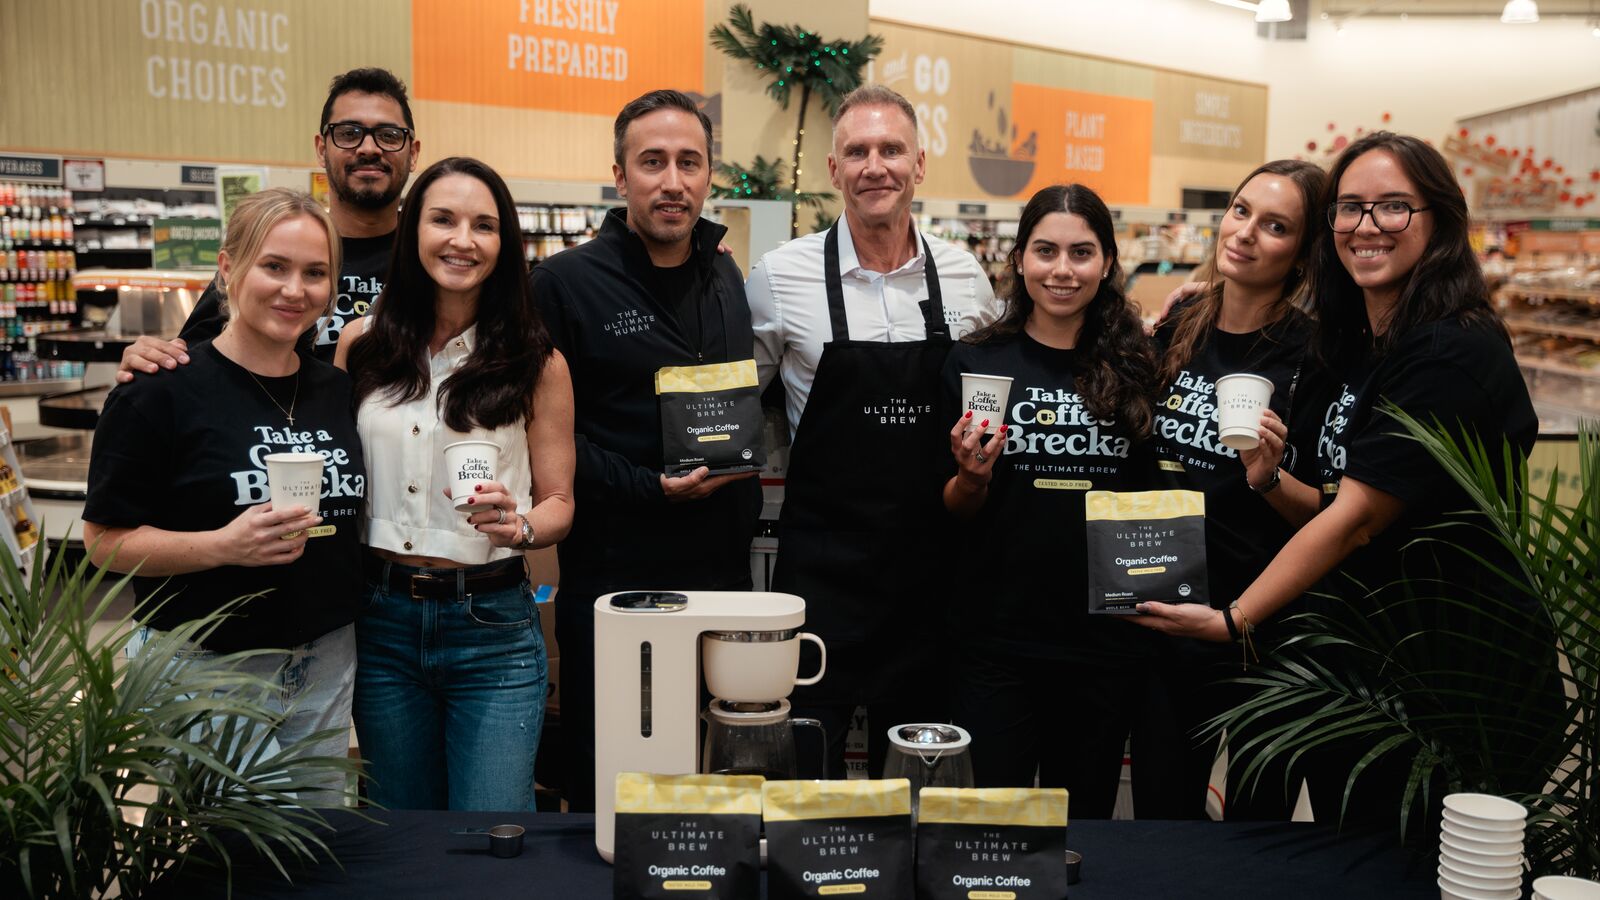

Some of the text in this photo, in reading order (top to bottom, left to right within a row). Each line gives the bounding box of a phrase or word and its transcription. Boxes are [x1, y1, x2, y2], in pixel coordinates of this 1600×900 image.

[519, 0, 619, 36] FRESHLY
[141, 0, 289, 54] ORGANIC
[507, 32, 629, 82] PREPARED
[915, 54, 950, 97] GO
[147, 56, 288, 109] CHOICES
[1065, 111, 1105, 139] PLANT
[343, 276, 386, 293] Tak
[617, 309, 638, 319] THE
[604, 315, 656, 331] ULTIMATE
[615, 323, 650, 337] HUMAN
[971, 395, 998, 404] Coffee
[975, 390, 991, 398] Take
[686, 400, 735, 410] ULTIMATE
[864, 405, 931, 414] ULTIMATE
[967, 401, 1001, 413] Brecka
[880, 416, 917, 424] BREW
[686, 423, 740, 435] Organic Coffee
[253, 426, 333, 445] Take a
[1002, 424, 1131, 459] Brecka
[1152, 414, 1238, 459] recka
[462, 463, 490, 471] Coffee
[1035, 464, 1085, 473] ULTIMATE
[1089, 466, 1118, 474] BREW
[1187, 458, 1216, 471] BREW
[458, 470, 494, 481] Brecka
[332, 508, 357, 517] BRE
[1116, 529, 1175, 539] ULTIMATE
[1130, 540, 1162, 548] BREW
[1115, 554, 1178, 567] Organic Coffee
[652, 831, 724, 839] ULTIMATE
[802, 833, 874, 845] ULTIMATE
[819, 846, 859, 856] BREW
[955, 841, 1028, 851] ULTIMATE
[972, 853, 1011, 861] BREW
[648, 864, 726, 878] Organic Coffee
[802, 867, 880, 883] Organic Coffee
[952, 875, 1031, 888] Organic Coffee
